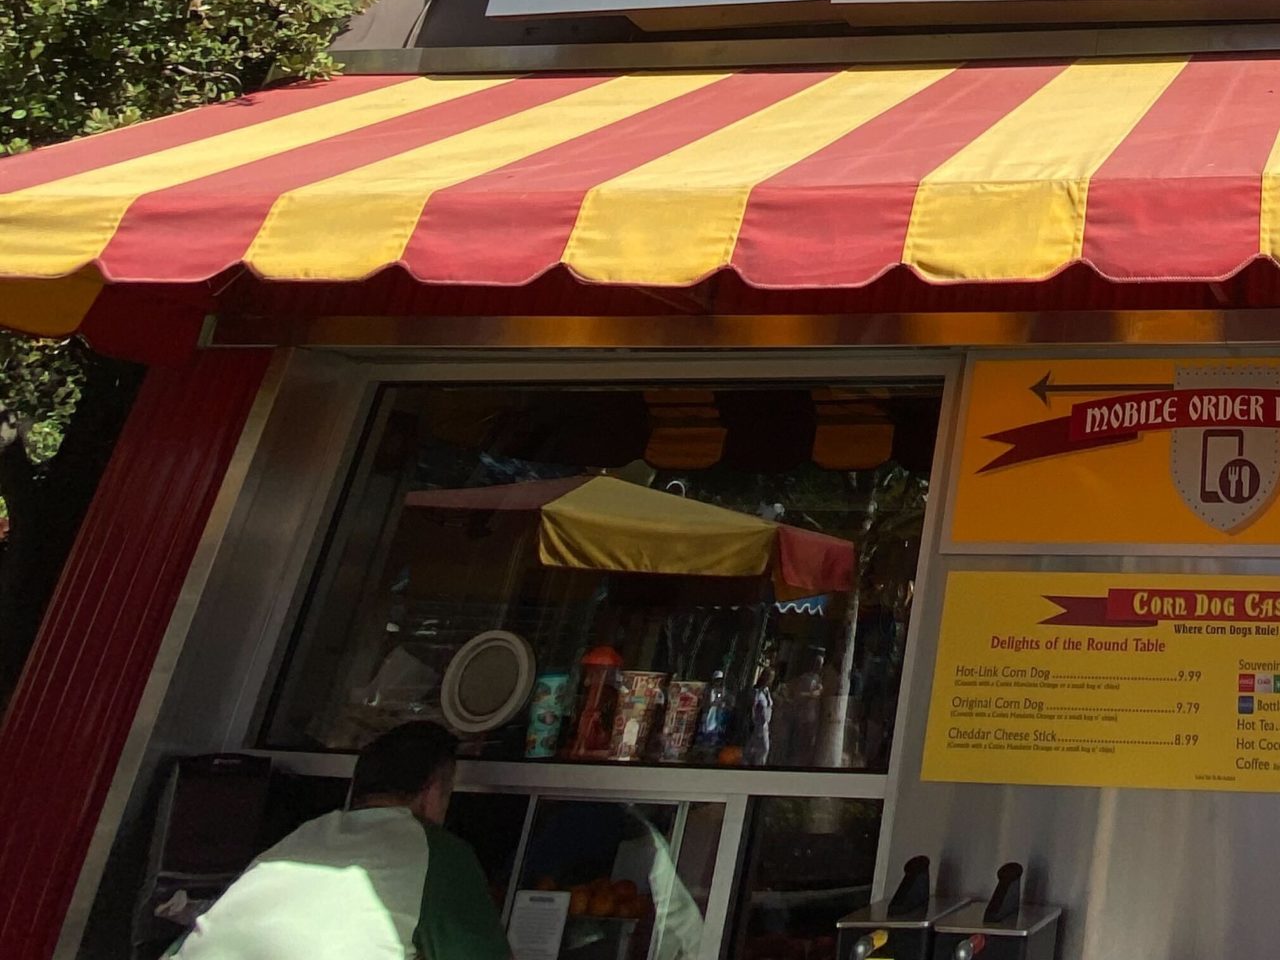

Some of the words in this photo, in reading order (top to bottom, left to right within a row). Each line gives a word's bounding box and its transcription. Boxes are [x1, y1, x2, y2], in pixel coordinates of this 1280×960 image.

[1086, 395, 1177, 433] MOBILE
[1188, 393, 1264, 423] ORDER
[1174, 624, 1203, 635] Where
[1205, 625, 1227, 636] Corn
[1229, 625, 1253, 638] Dogs
[1254, 625, 1280, 637] Rule!
[990, 635, 1041, 652] Delights
[1045, 637, 1060, 651] of
[1062, 637, 1082, 652] the
[1087, 638, 1128, 653] Round
[1133, 638, 1166, 653] Table
[1238, 659, 1280, 672] Souvenir
[955, 665, 999, 678] Hot-Link
[1001, 666, 1027, 678] Corn
[1030, 666, 1051, 681] Dog
[1177, 670, 1202, 682] 9.99
[952, 695, 992, 710] Original
[994, 697, 1020, 710] Corn
[1023, 697, 1044, 712] Dog
[1176, 702, 1200, 714] 9.79
[1236, 719, 1256, 731] Hot
[1259, 719, 1275, 732] Tea
[948, 727, 991, 741] Cheddar
[994, 728, 1031, 741] Cheese
[1033, 729, 1057, 742] Stick
[1174, 734, 1199, 746] 8.99
[1236, 738, 1256, 751] Hot
[1235, 757, 1270, 771] Coffee
